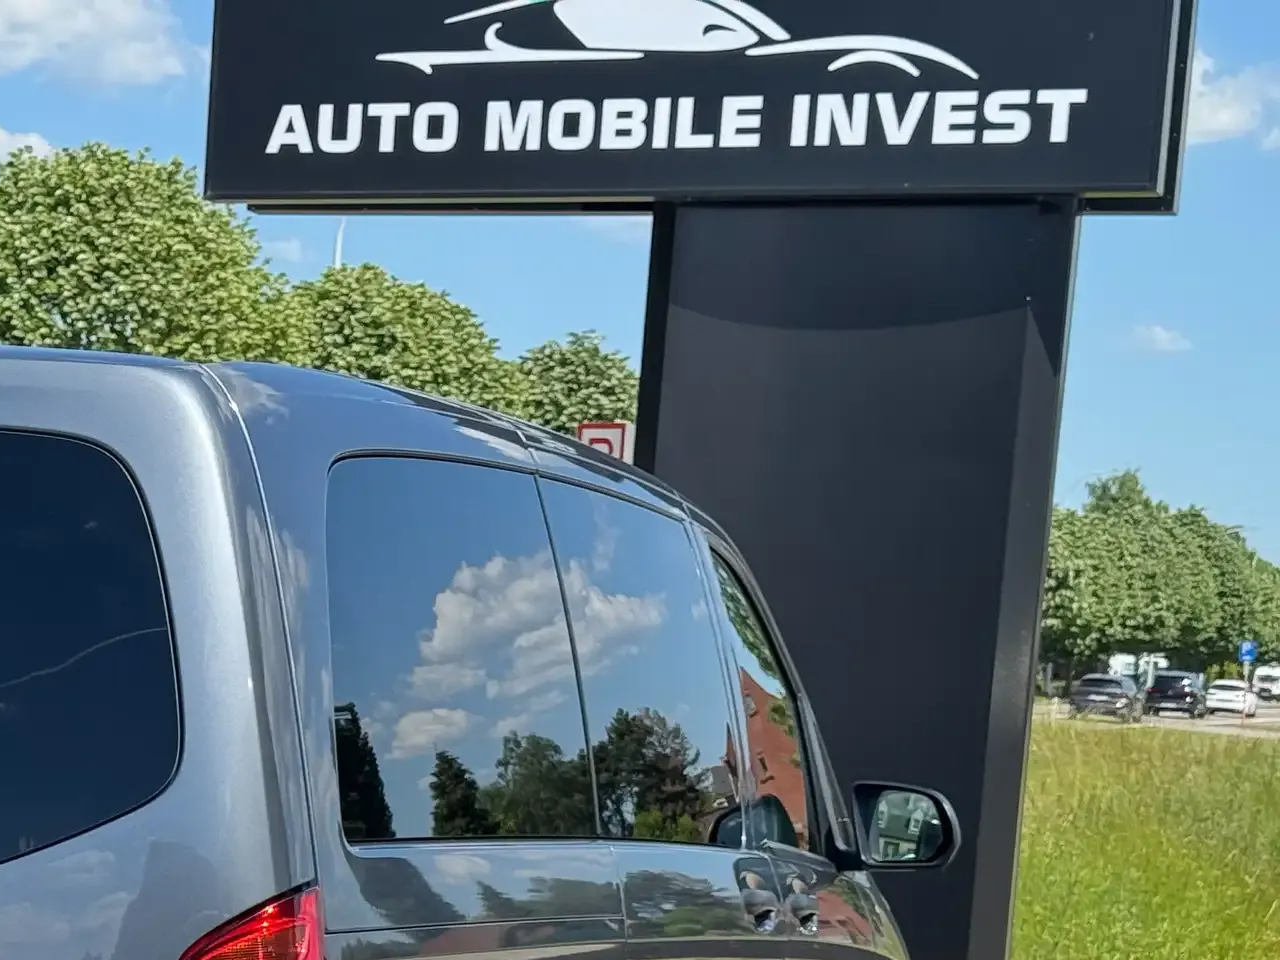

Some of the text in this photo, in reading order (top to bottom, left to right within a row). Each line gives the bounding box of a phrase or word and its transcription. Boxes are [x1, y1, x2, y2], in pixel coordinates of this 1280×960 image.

[264, 88, 1089, 154] AUTO MOBILE INVEST
